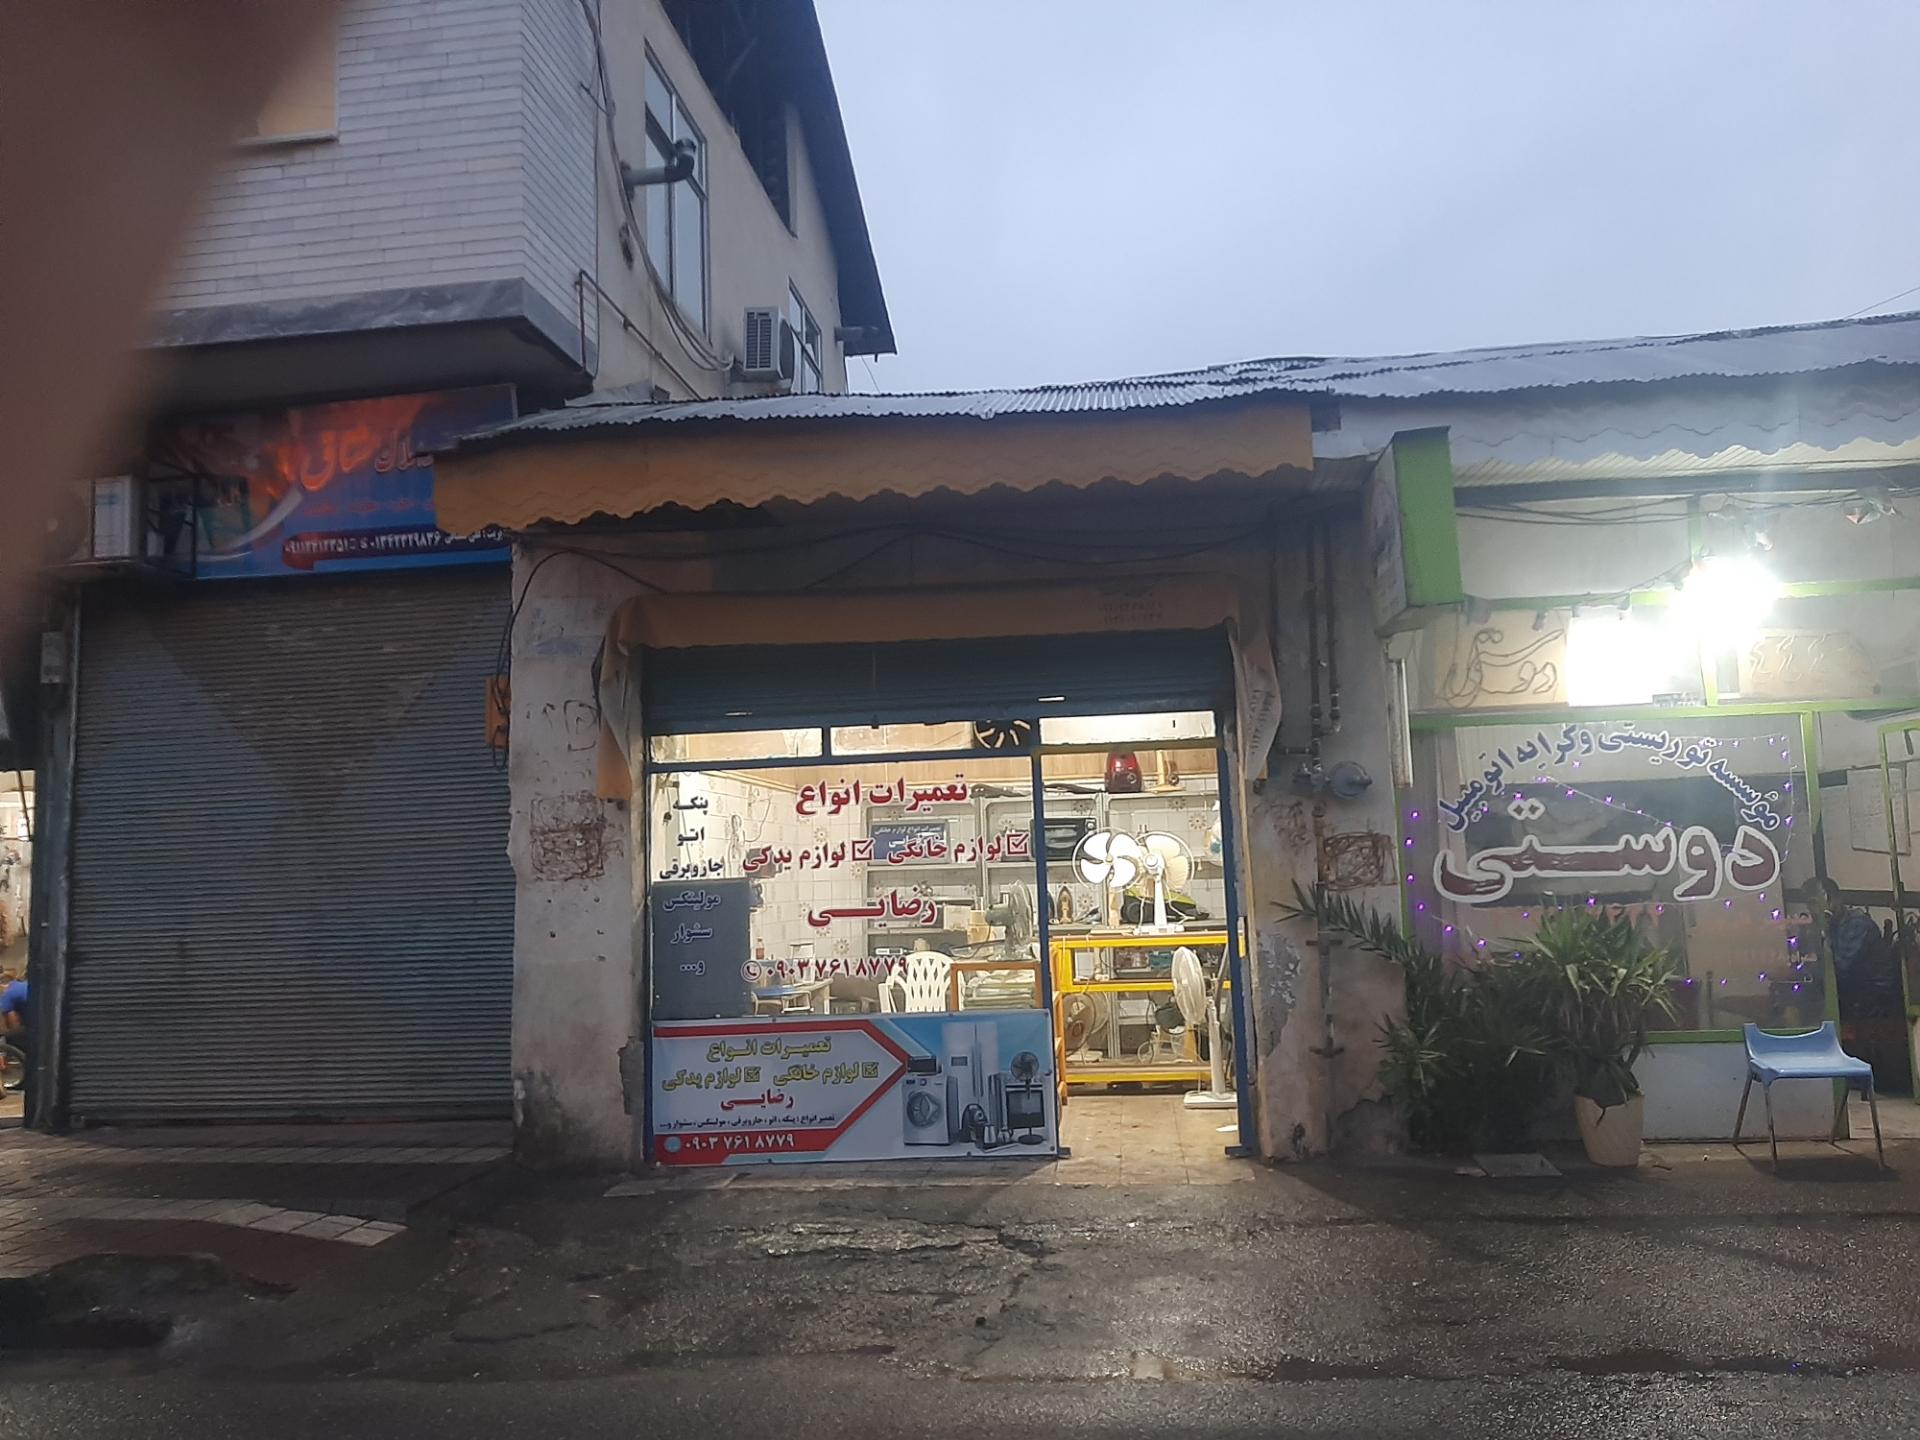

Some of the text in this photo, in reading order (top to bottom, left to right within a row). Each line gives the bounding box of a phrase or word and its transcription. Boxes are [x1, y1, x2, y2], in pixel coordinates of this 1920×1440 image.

[672, 796, 709, 815] پنکه
[795, 774, 968, 815] تعمیرات انواع
[677, 826, 705, 846] اتو
[742, 834, 1001, 872] لوازم خانگی لوازم یدکی
[1433, 797, 1781, 903] دوستی
[807, 885, 937, 928] رضایی
[671, 922, 714, 944] سشوار
[706, 1036, 832, 1062] تعمیرات انواع
[662, 1062, 860, 1091] لوازم خانگی لوازم یدکی
[720, 1088, 794, 1111] رضایی
[685, 1136, 719, 1150] ۰۹۰۳
[755, 1133, 794, 1149] ۸۷۷۹
